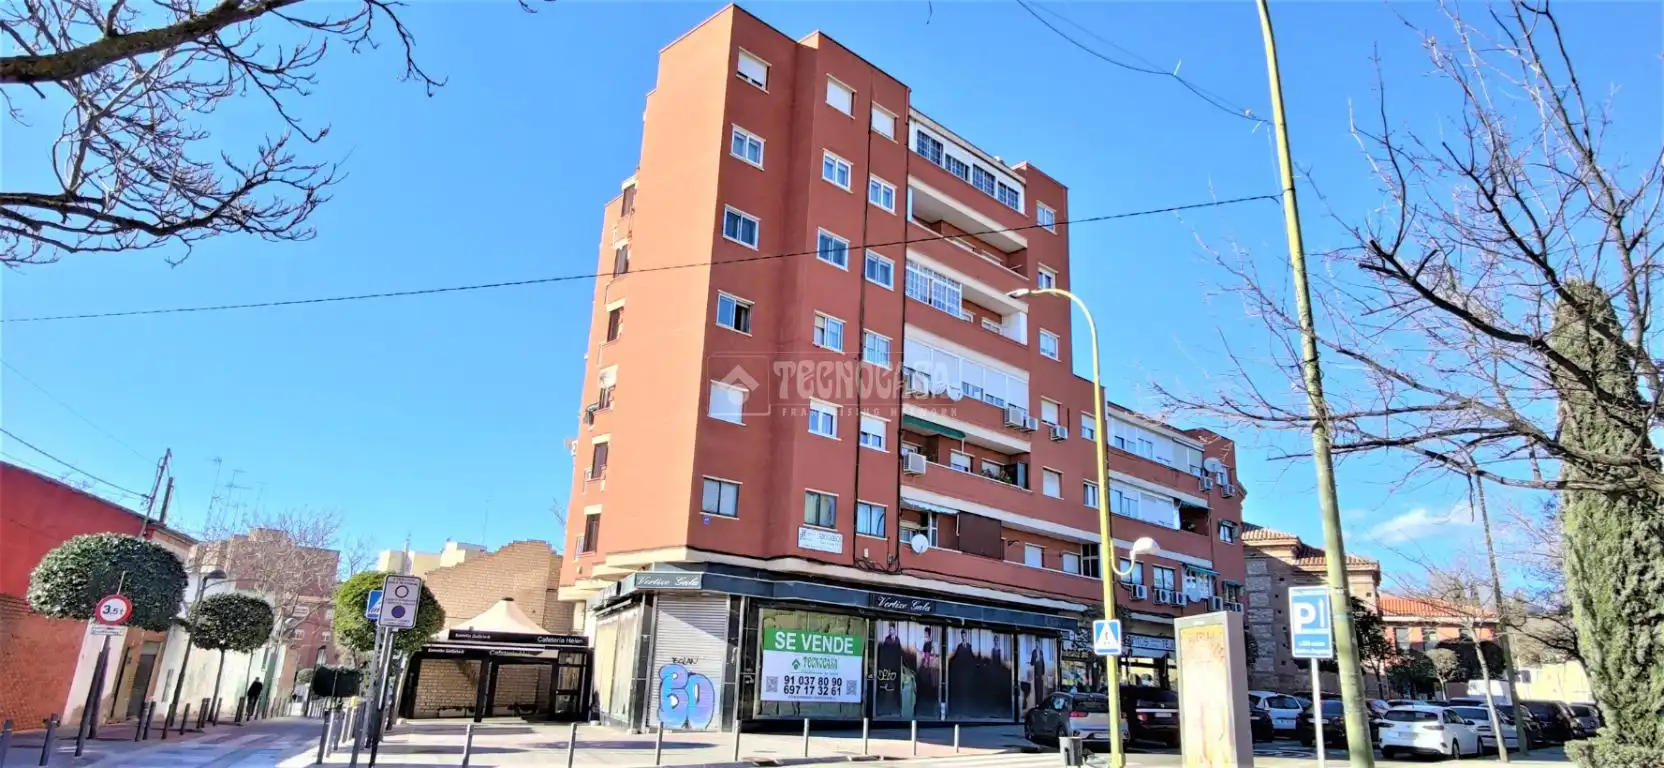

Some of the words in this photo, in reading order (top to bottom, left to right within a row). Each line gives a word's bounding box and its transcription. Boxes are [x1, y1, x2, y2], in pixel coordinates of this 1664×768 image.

[1292, 602, 1317, 634] P
[775, 631, 797, 650] SE
[800, 634, 854, 654] VENDE
[803, 656, 838, 670] TECNOCASA
[784, 675, 795, 685] 91
[798, 676, 815, 686] 037
[817, 677, 829, 686] 80
[831, 677, 843, 687] 90
[783, 685, 801, 695] 697
[804, 686, 815, 695] 17
[817, 686, 829, 696] 32
[831, 687, 841, 696] 61
